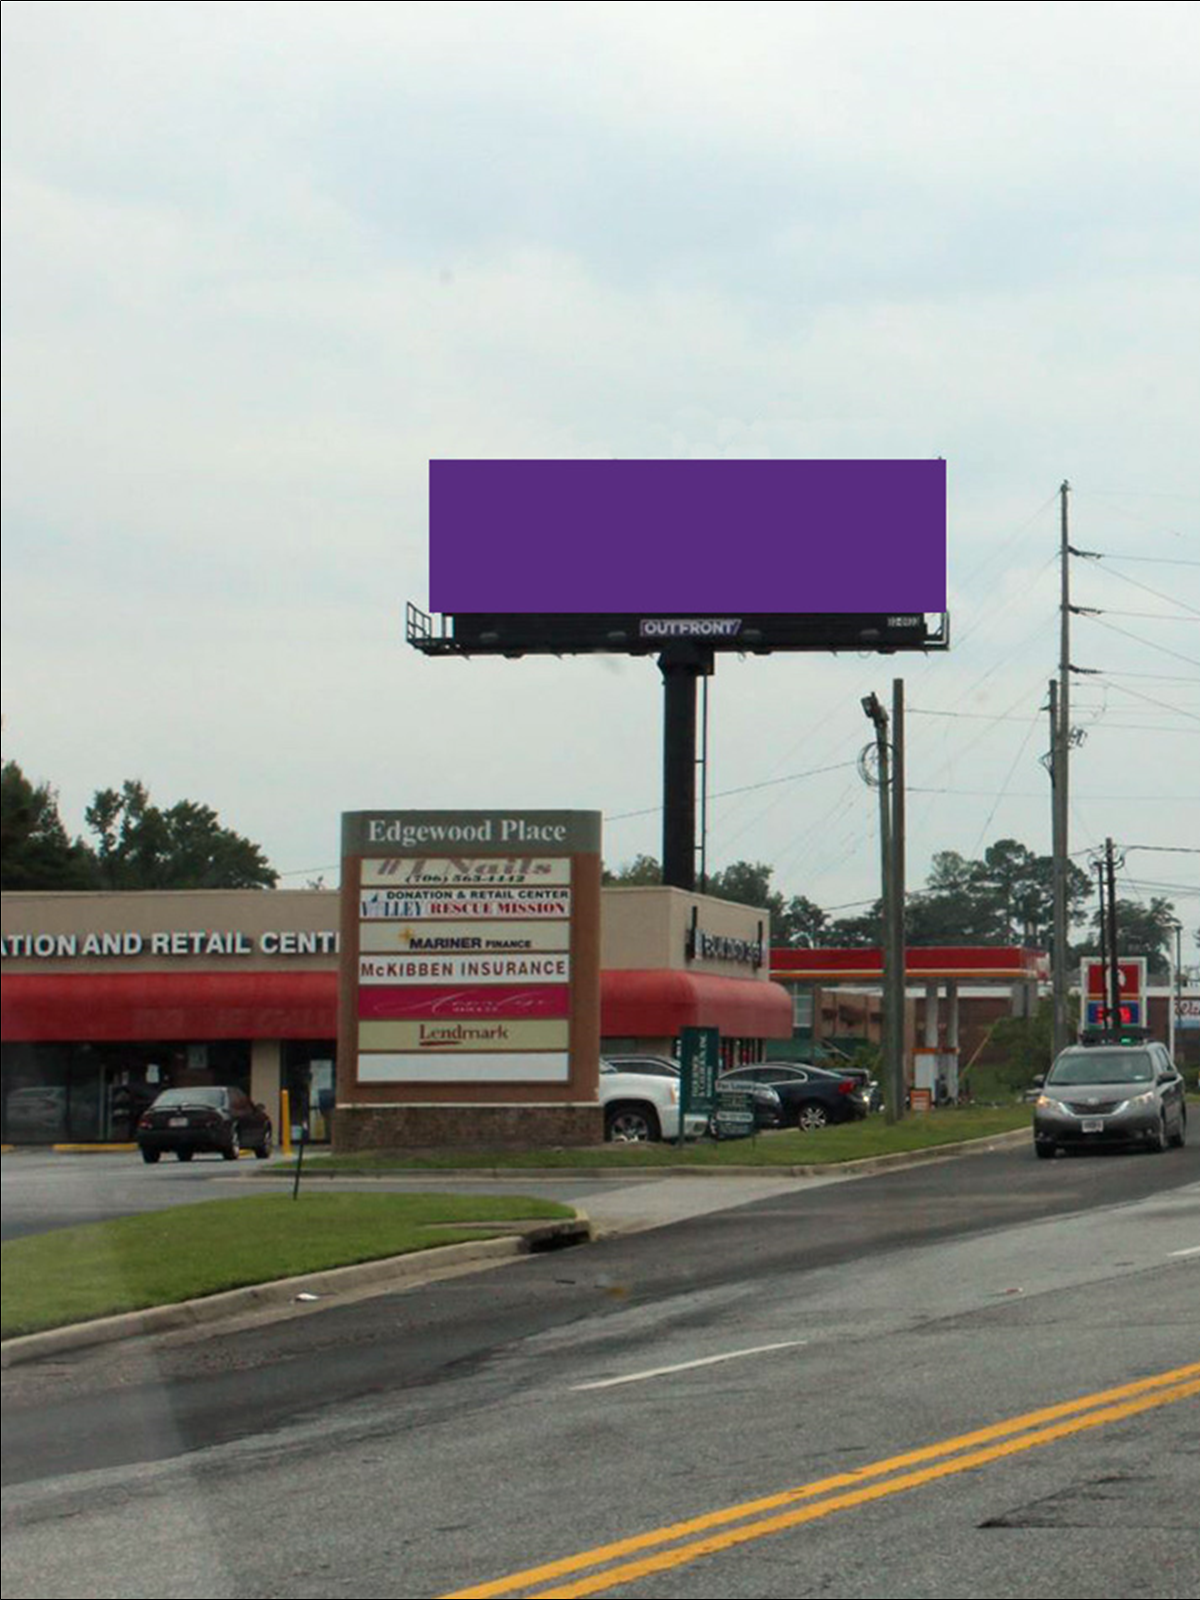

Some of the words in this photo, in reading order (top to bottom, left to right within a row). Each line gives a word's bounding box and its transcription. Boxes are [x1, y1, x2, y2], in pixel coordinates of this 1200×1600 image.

[644, 621, 734, 636] OUTFRONT
[368, 819, 492, 846] Edgewood
[500, 819, 567, 842] Place
[441, 858, 552, 875] Nails
[386, 890, 453, 900] DONATION
[456, 890, 466, 900] &
[470, 890, 512, 900] RETAIL
[517, 890, 569, 899] CENTER
[429, 903, 493, 914] RESCUE
[498, 902, 566, 914] MISSION
[82, 932, 143, 956] AND
[151, 932, 251, 955] RETAIL
[259, 931, 340, 955] CENT
[409, 937, 482, 949] MARINER
[485, 939, 532, 948] FINANCE
[360, 962, 454, 977] McKIBBEN
[460, 960, 566, 976] INSURANCE
[419, 1023, 508, 1041] Lendmark
